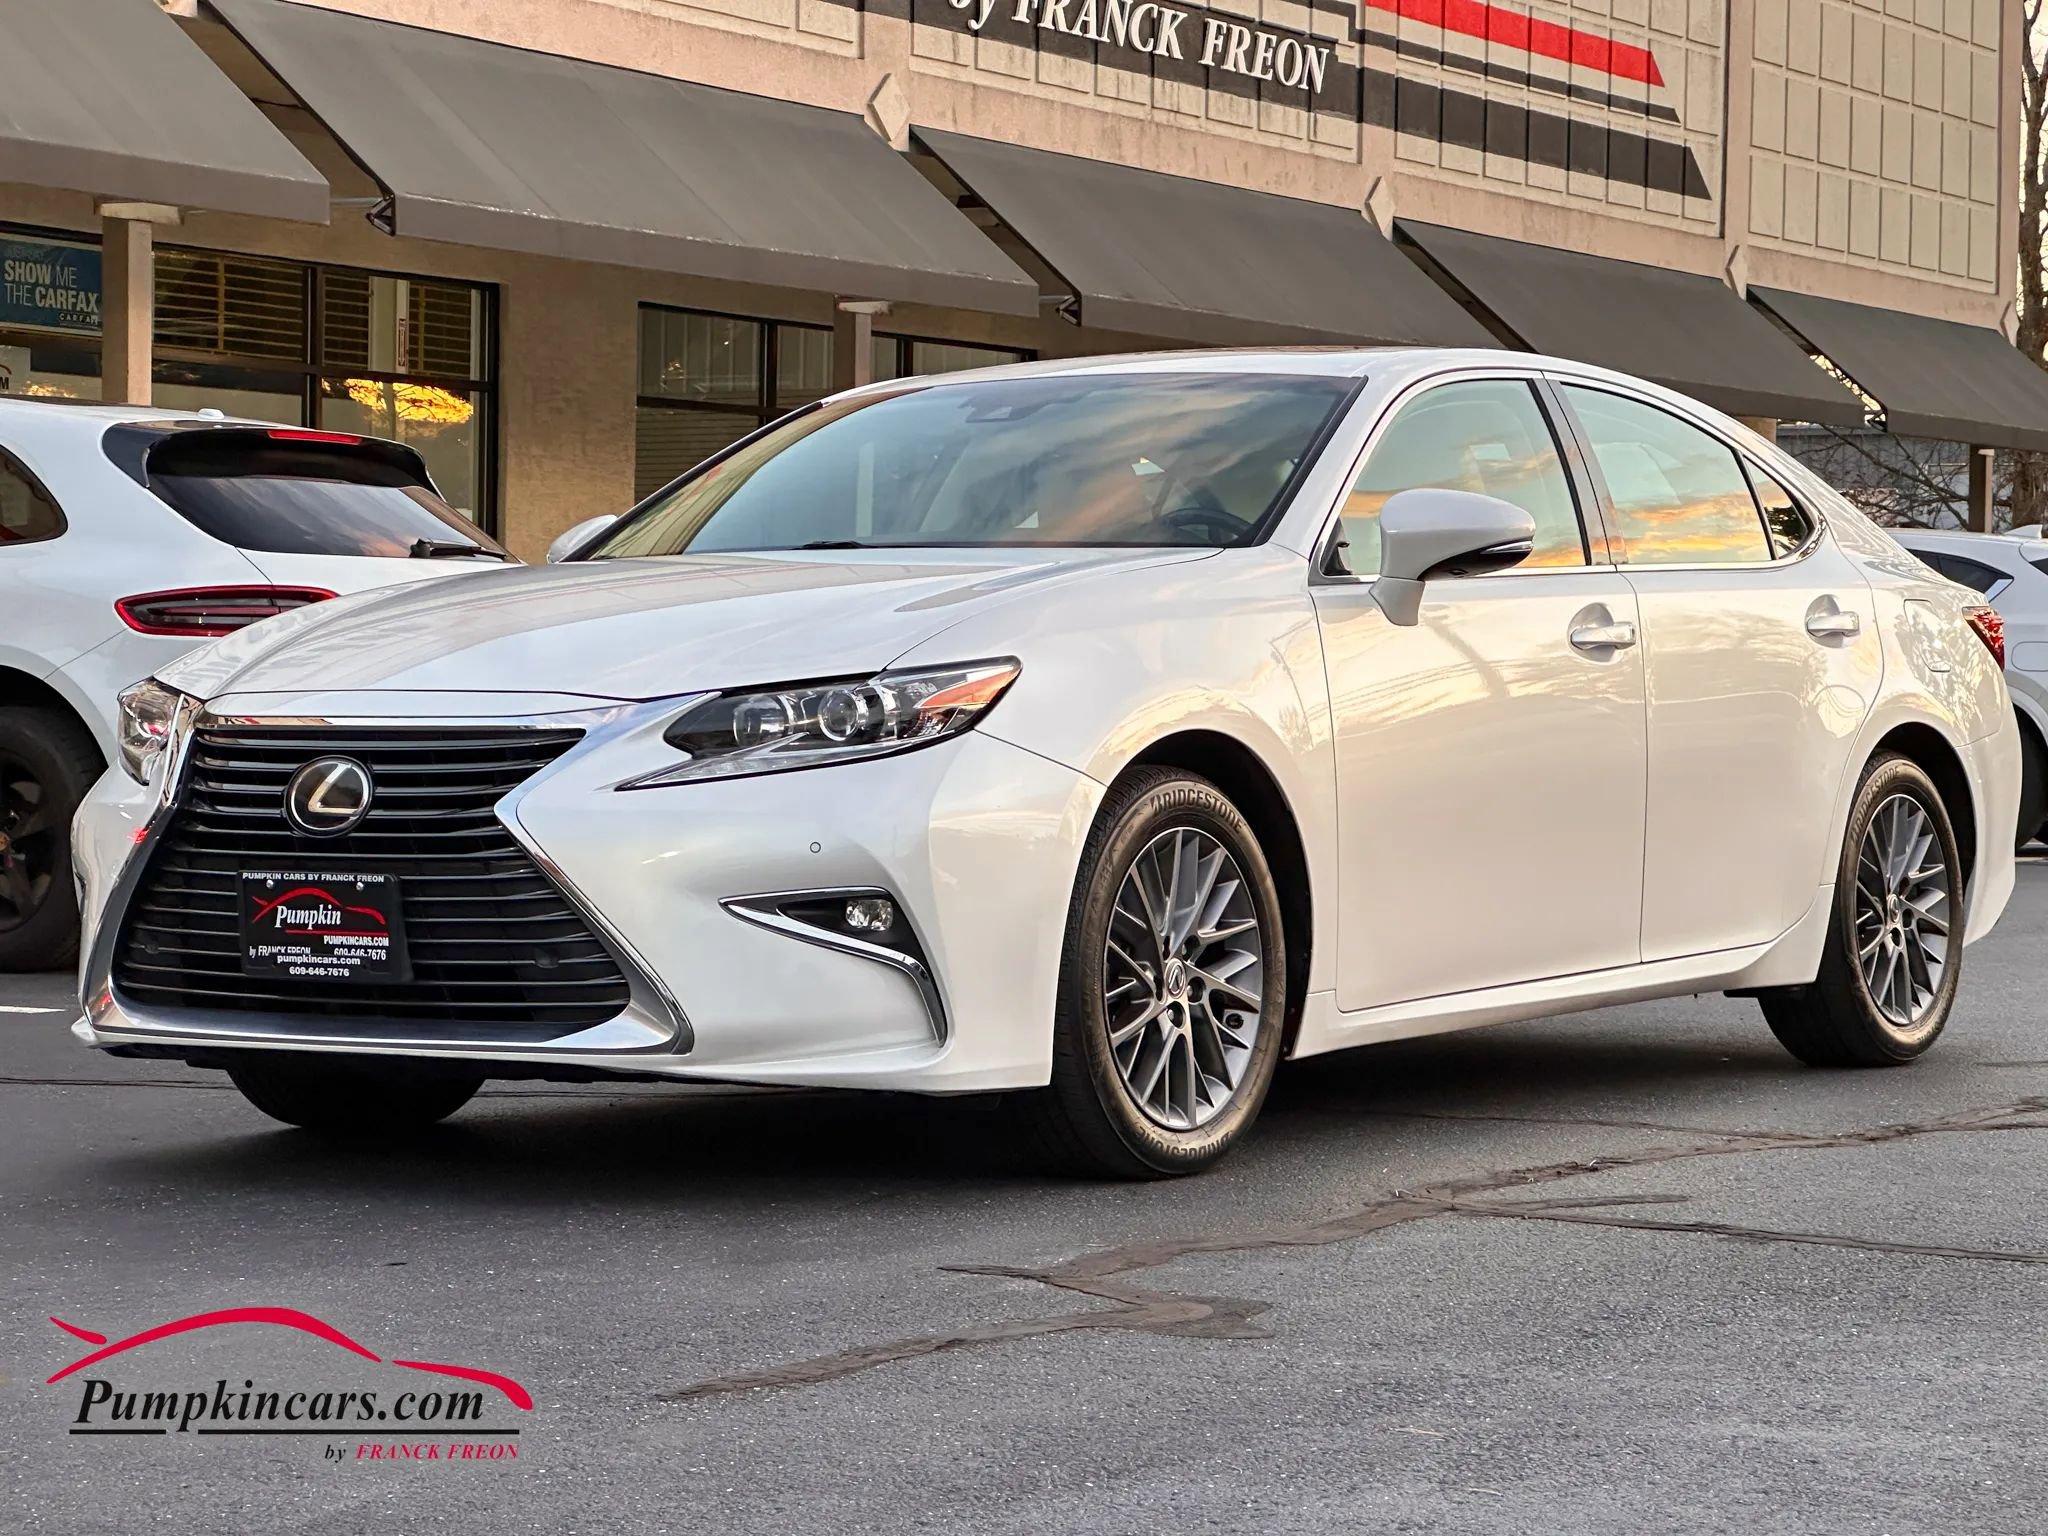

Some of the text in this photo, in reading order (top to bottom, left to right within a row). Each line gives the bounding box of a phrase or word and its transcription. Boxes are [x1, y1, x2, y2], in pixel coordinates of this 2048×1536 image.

[949, 0, 997, 30] y
[1198, 17, 1330, 94] FREON
[4, 259, 78, 288] SHOW ME
[4, 282, 99, 313] THE CARFAX
[1150, 788, 1242, 834] BRIDGESTONE
[242, 872, 385, 883] PUMPKIN CARS BY FRANCK FREON
[274, 903, 342, 930] Pumpkin
[324, 935, 389, 947] PUMPKINCARS.COM
[249, 946, 256, 958] by
[277, 954, 361, 965] pumpkincars.com
[289, 966, 350, 977] 609-646-7676
